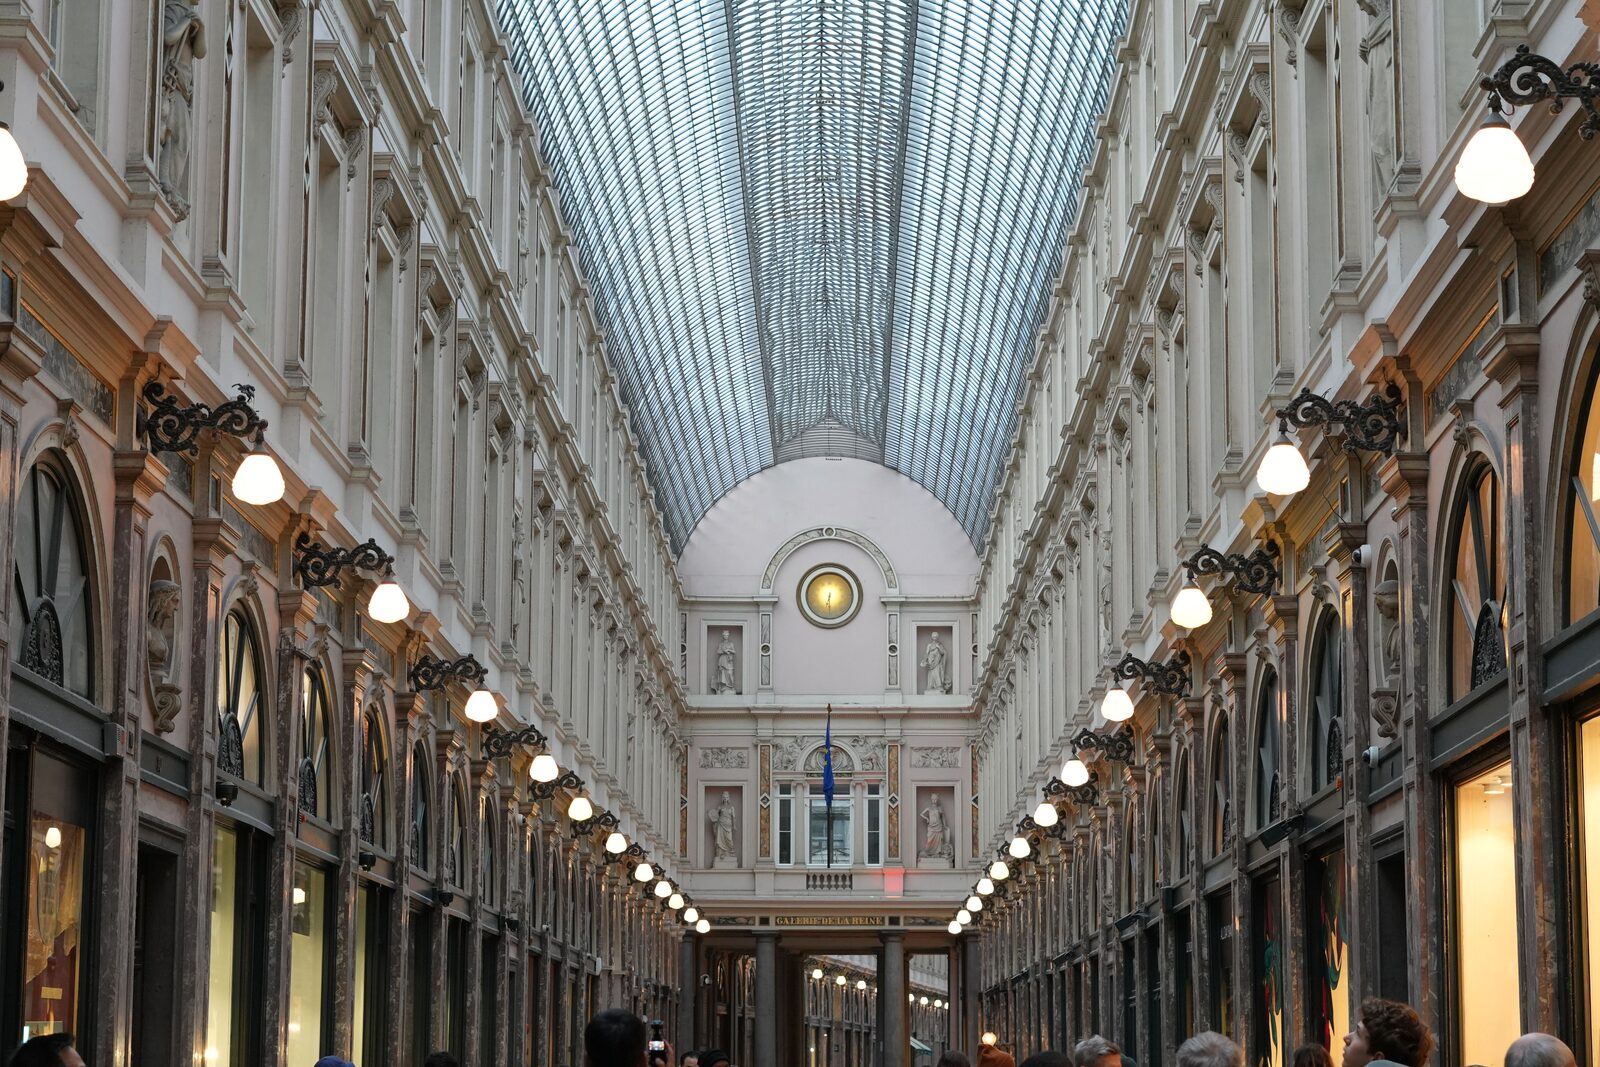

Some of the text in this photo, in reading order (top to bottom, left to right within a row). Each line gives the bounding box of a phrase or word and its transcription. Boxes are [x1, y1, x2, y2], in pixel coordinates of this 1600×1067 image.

[776, 917, 882, 925] GALERIE DE LA REINE
